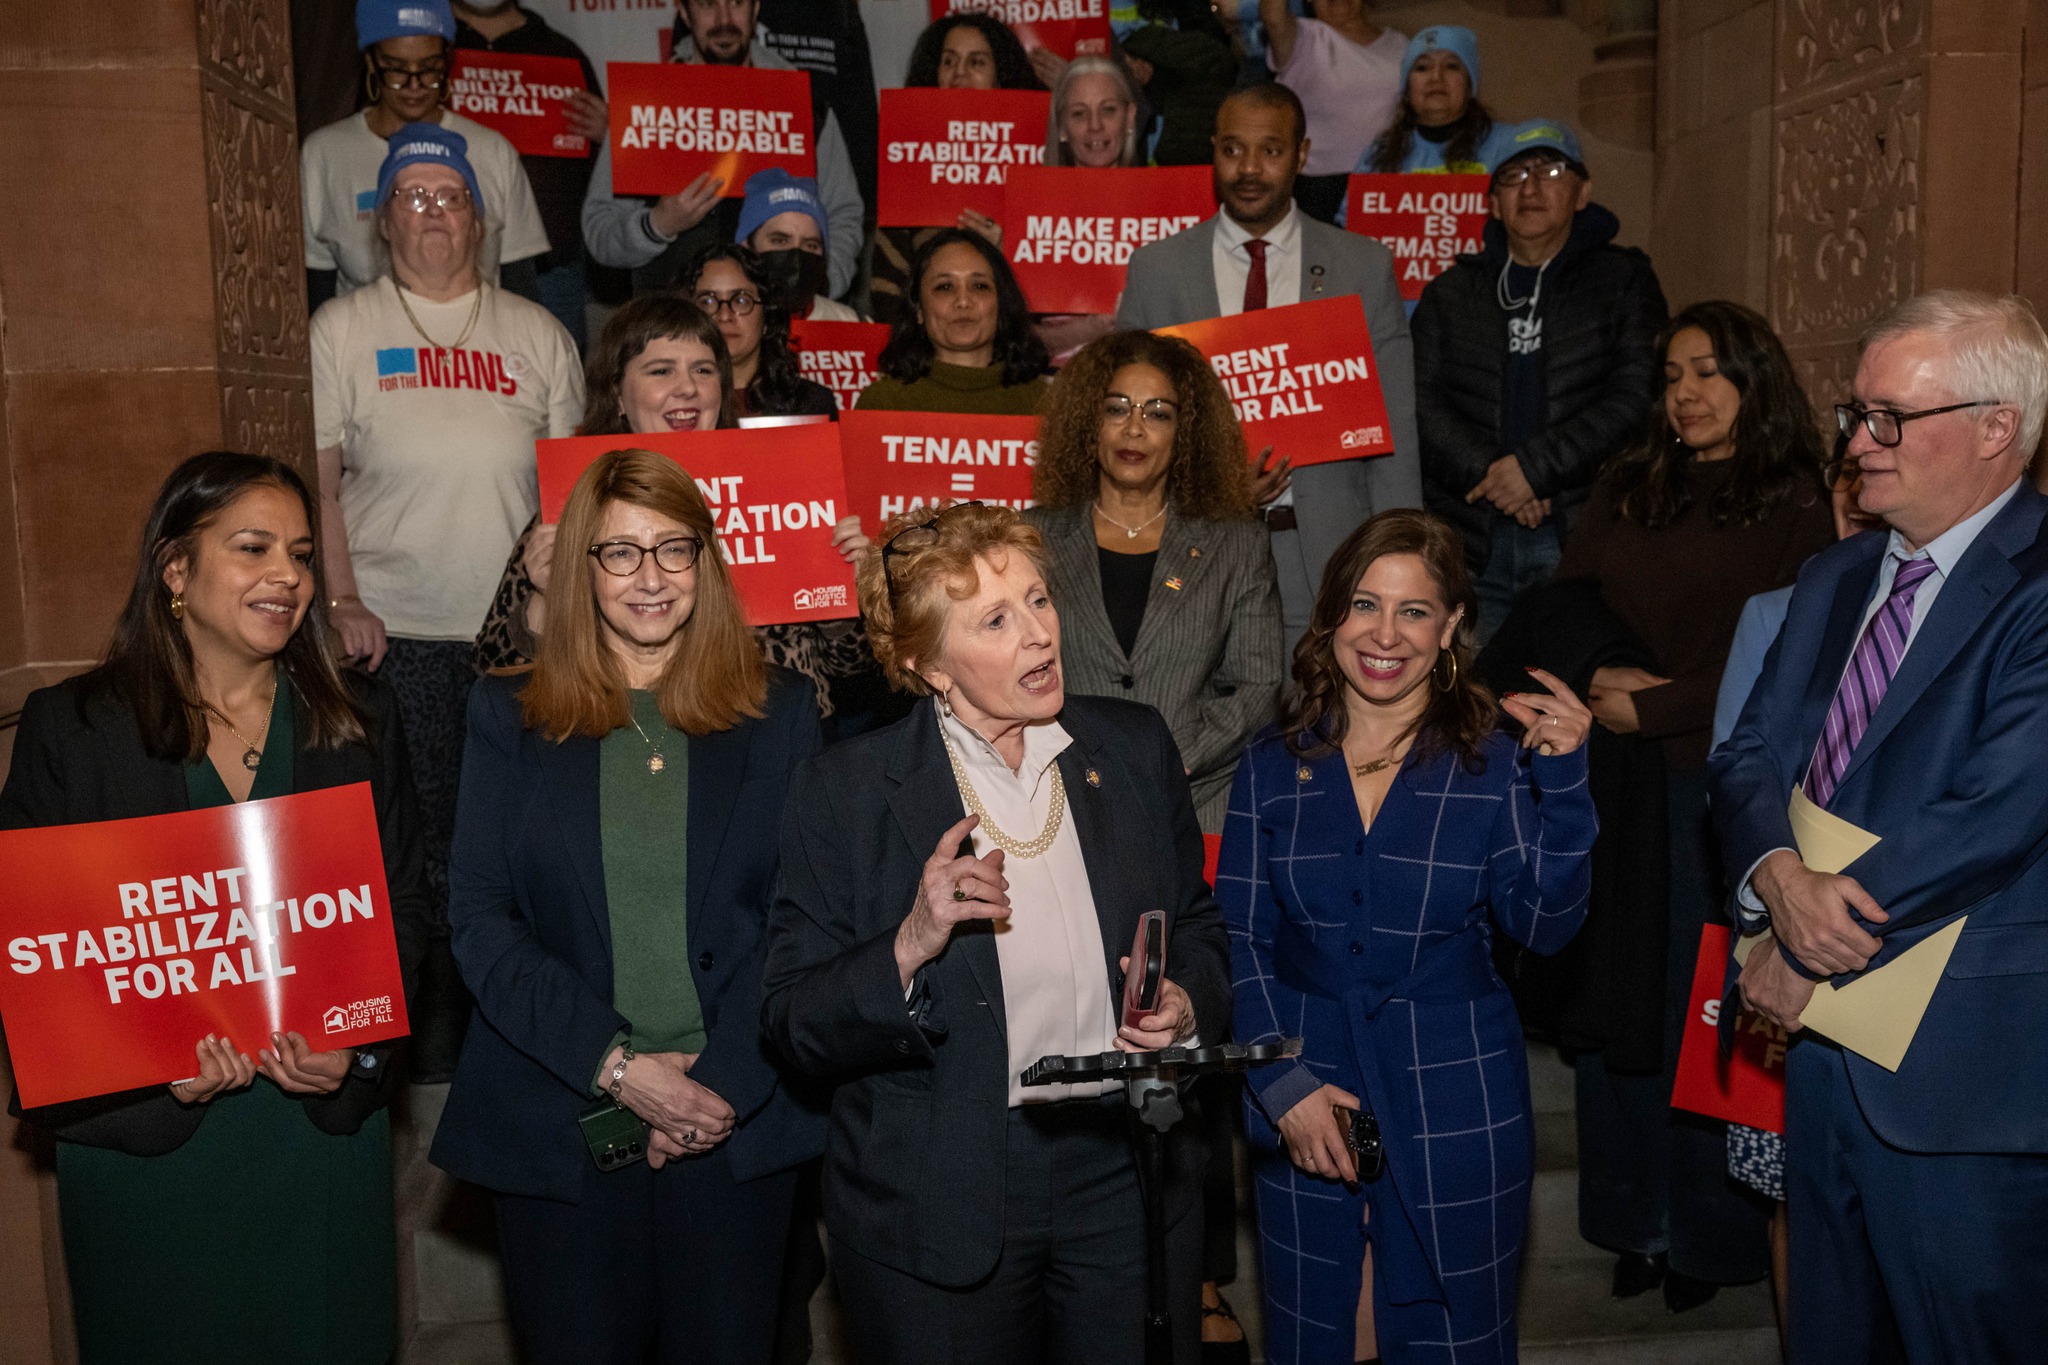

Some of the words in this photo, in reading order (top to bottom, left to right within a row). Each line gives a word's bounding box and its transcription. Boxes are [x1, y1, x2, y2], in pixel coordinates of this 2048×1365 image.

[462, 66, 523, 82] RENT
[452, 94, 499, 114] FOR
[503, 97, 546, 117] ALL
[631, 105, 714, 130] MAKE
[719, 108, 793, 134] RENT
[621, 126, 806, 156] AFFORDABLE
[948, 120, 1015, 143] RENT
[931, 163, 981, 185] FOR
[1362, 191, 1393, 214] EL
[1396, 191, 1489, 218] ALQUIL
[1027, 215, 1115, 242] MAKE
[1424, 214, 1459, 237] ES
[799, 350, 866, 371] RENT
[1210, 343, 1290, 378] RENT
[378, 376, 399, 393] FOR
[399, 374, 419, 389] THE
[1269, 389, 1324, 419] ALL
[881, 435, 1041, 467] TENANTS
[813, 585, 847, 594] HOUSING
[815, 591, 848, 602] JUSTICE
[833, 598, 848, 607] ALL
[118, 866, 248, 920] RENT
[7, 884, 375, 975] STABILIZATION
[104, 957, 199, 1005] FOR
[209, 943, 297, 990] ALL
[348, 995, 391, 1011] HOUSING
[350, 1004, 393, 1020] JUSTICE
[351, 1018, 371, 1029] FOR
[375, 1013, 394, 1024] ALL
